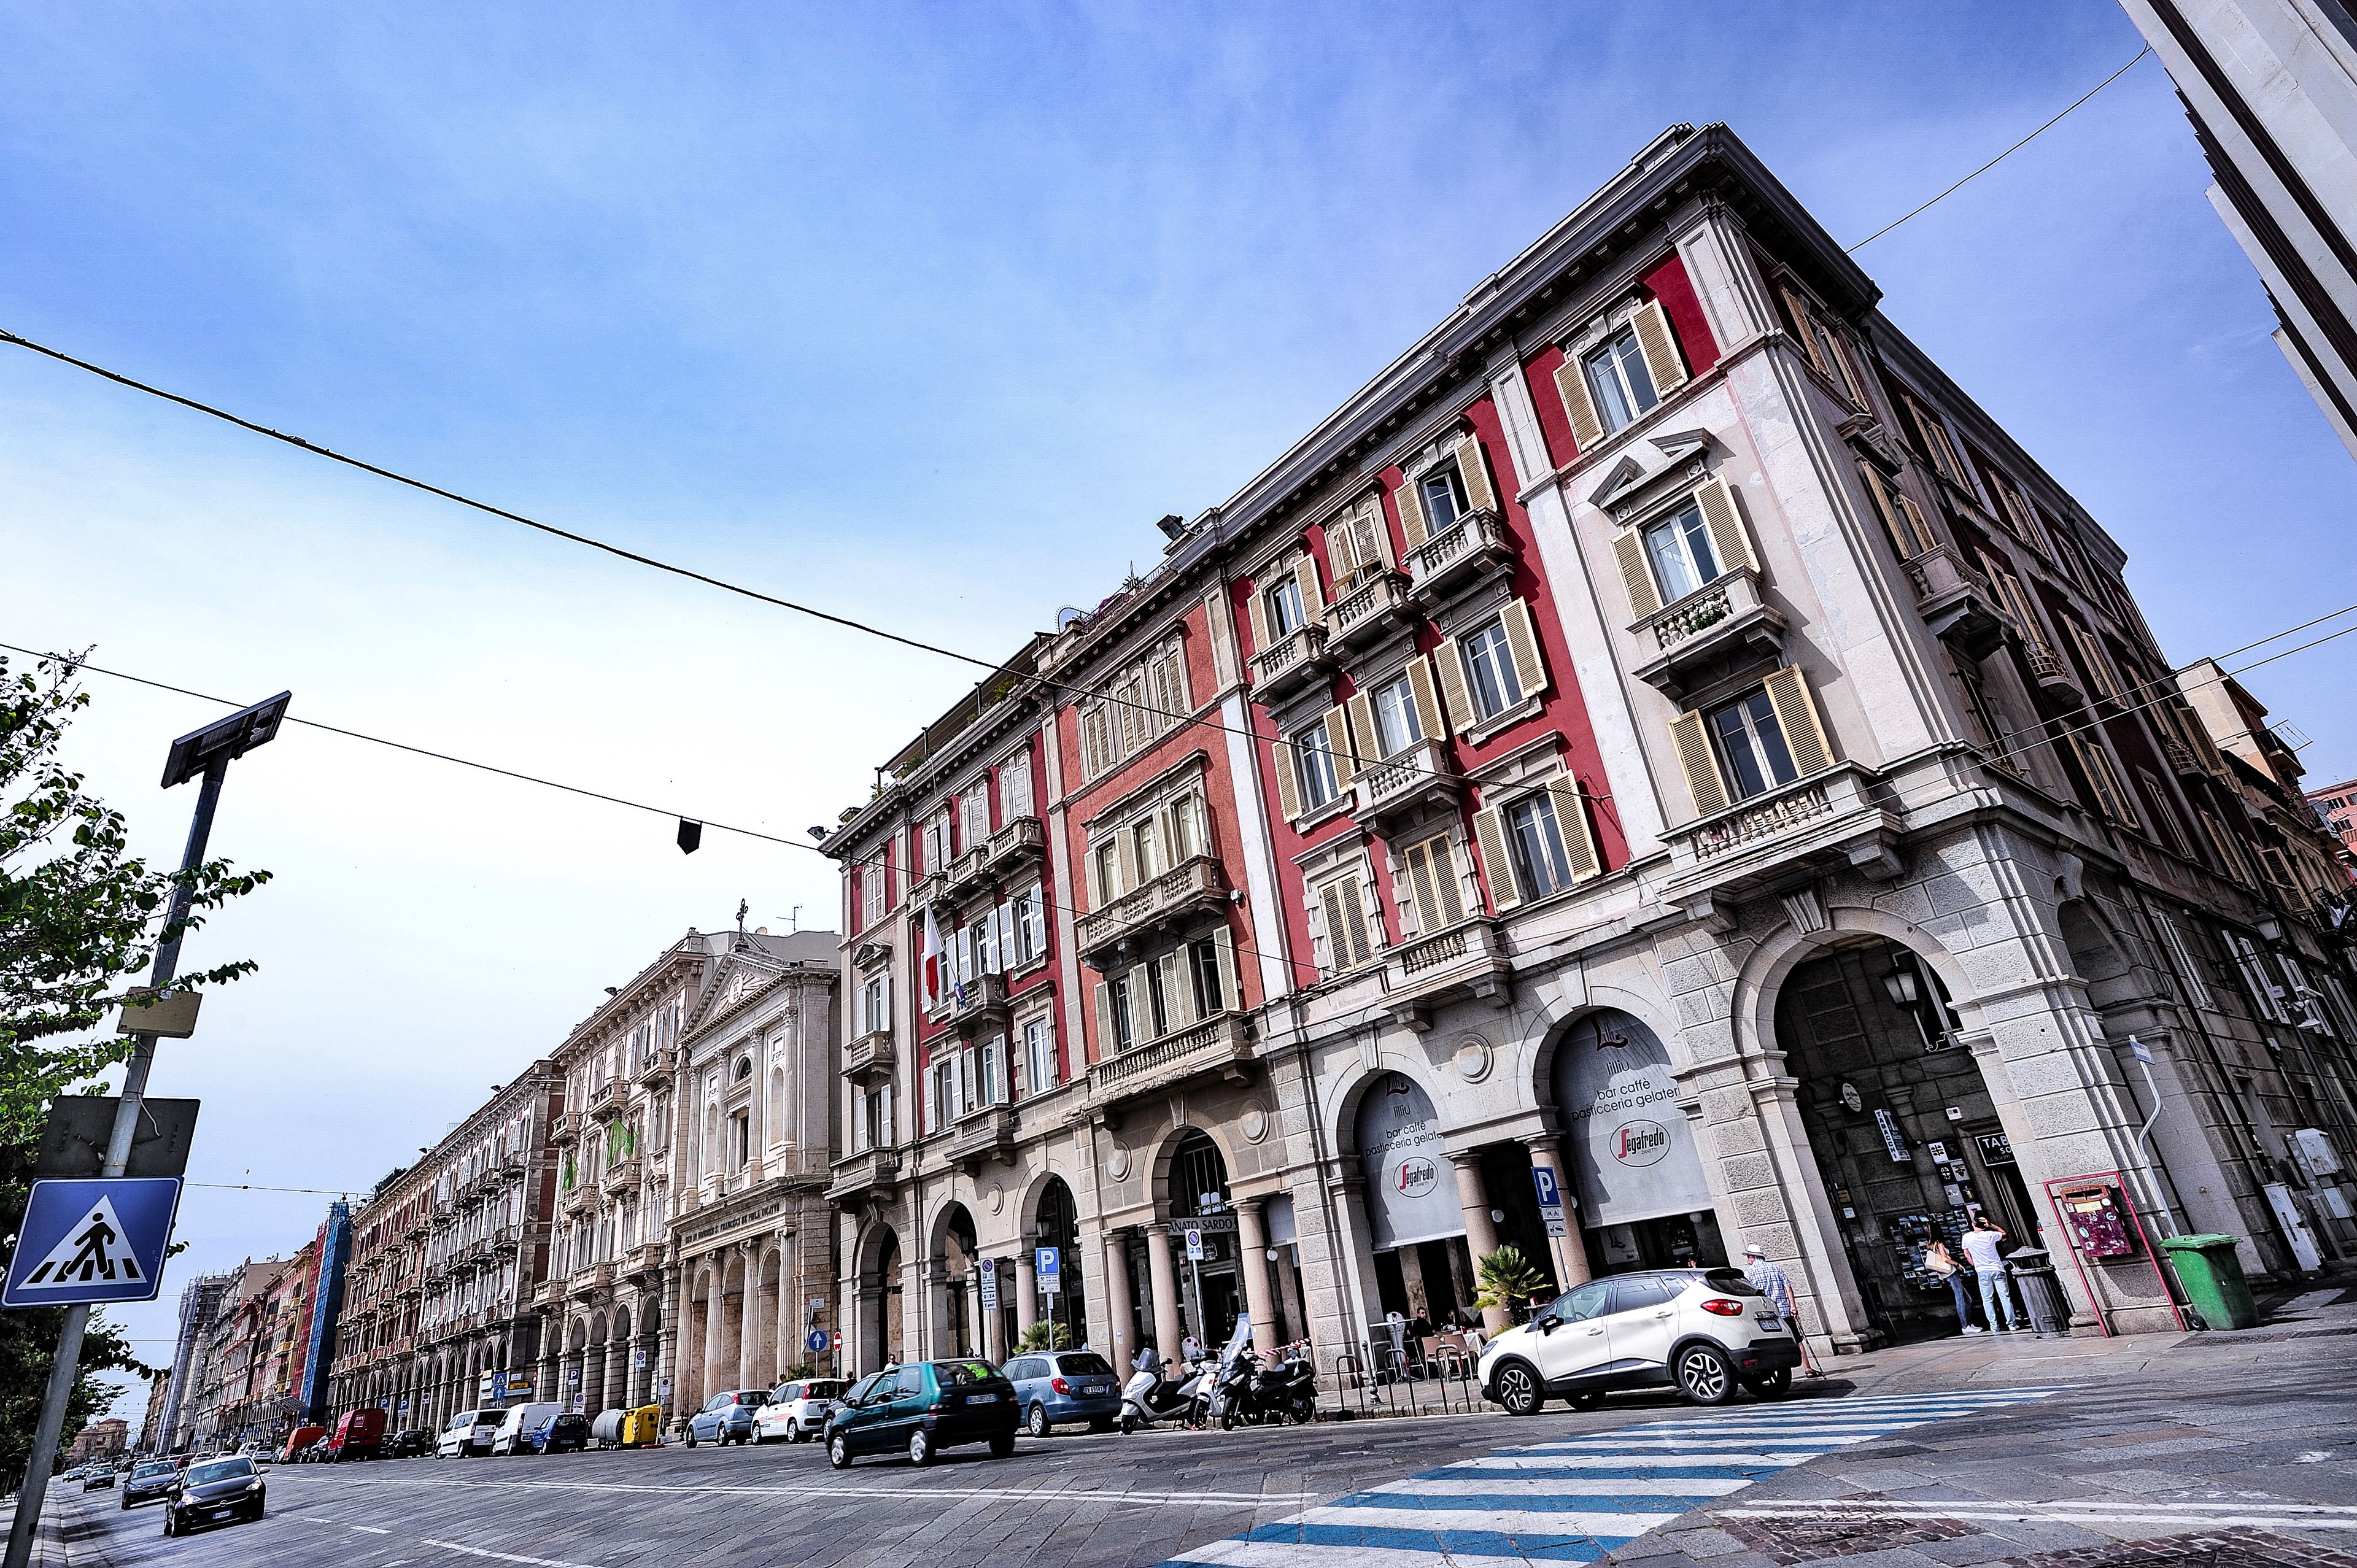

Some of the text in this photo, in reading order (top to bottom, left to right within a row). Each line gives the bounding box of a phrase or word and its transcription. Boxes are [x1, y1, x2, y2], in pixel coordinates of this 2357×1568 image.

[1606, 1060, 1630, 1075] lilliu
[1596, 1078, 1651, 1101] bar caffè
[1393, 1105, 1411, 1118] lilliu
[1571, 1098, 1633, 1123] pasticceria
[1386, 1120, 1426, 1140] bar caffè
[1876, 1111, 1897, 1159] TABACCHI
[1365, 1137, 1412, 1158] pasticceria
[1618, 1127, 1665, 1159] Segafredo
[1982, 1135, 2009, 1149] TAB
[1399, 1163, 1434, 1191] Segafredo
[1538, 1172, 1552, 1202] P
[1202, 1218, 1233, 1230] SARDO
[1040, 1250, 1055, 1272] P
